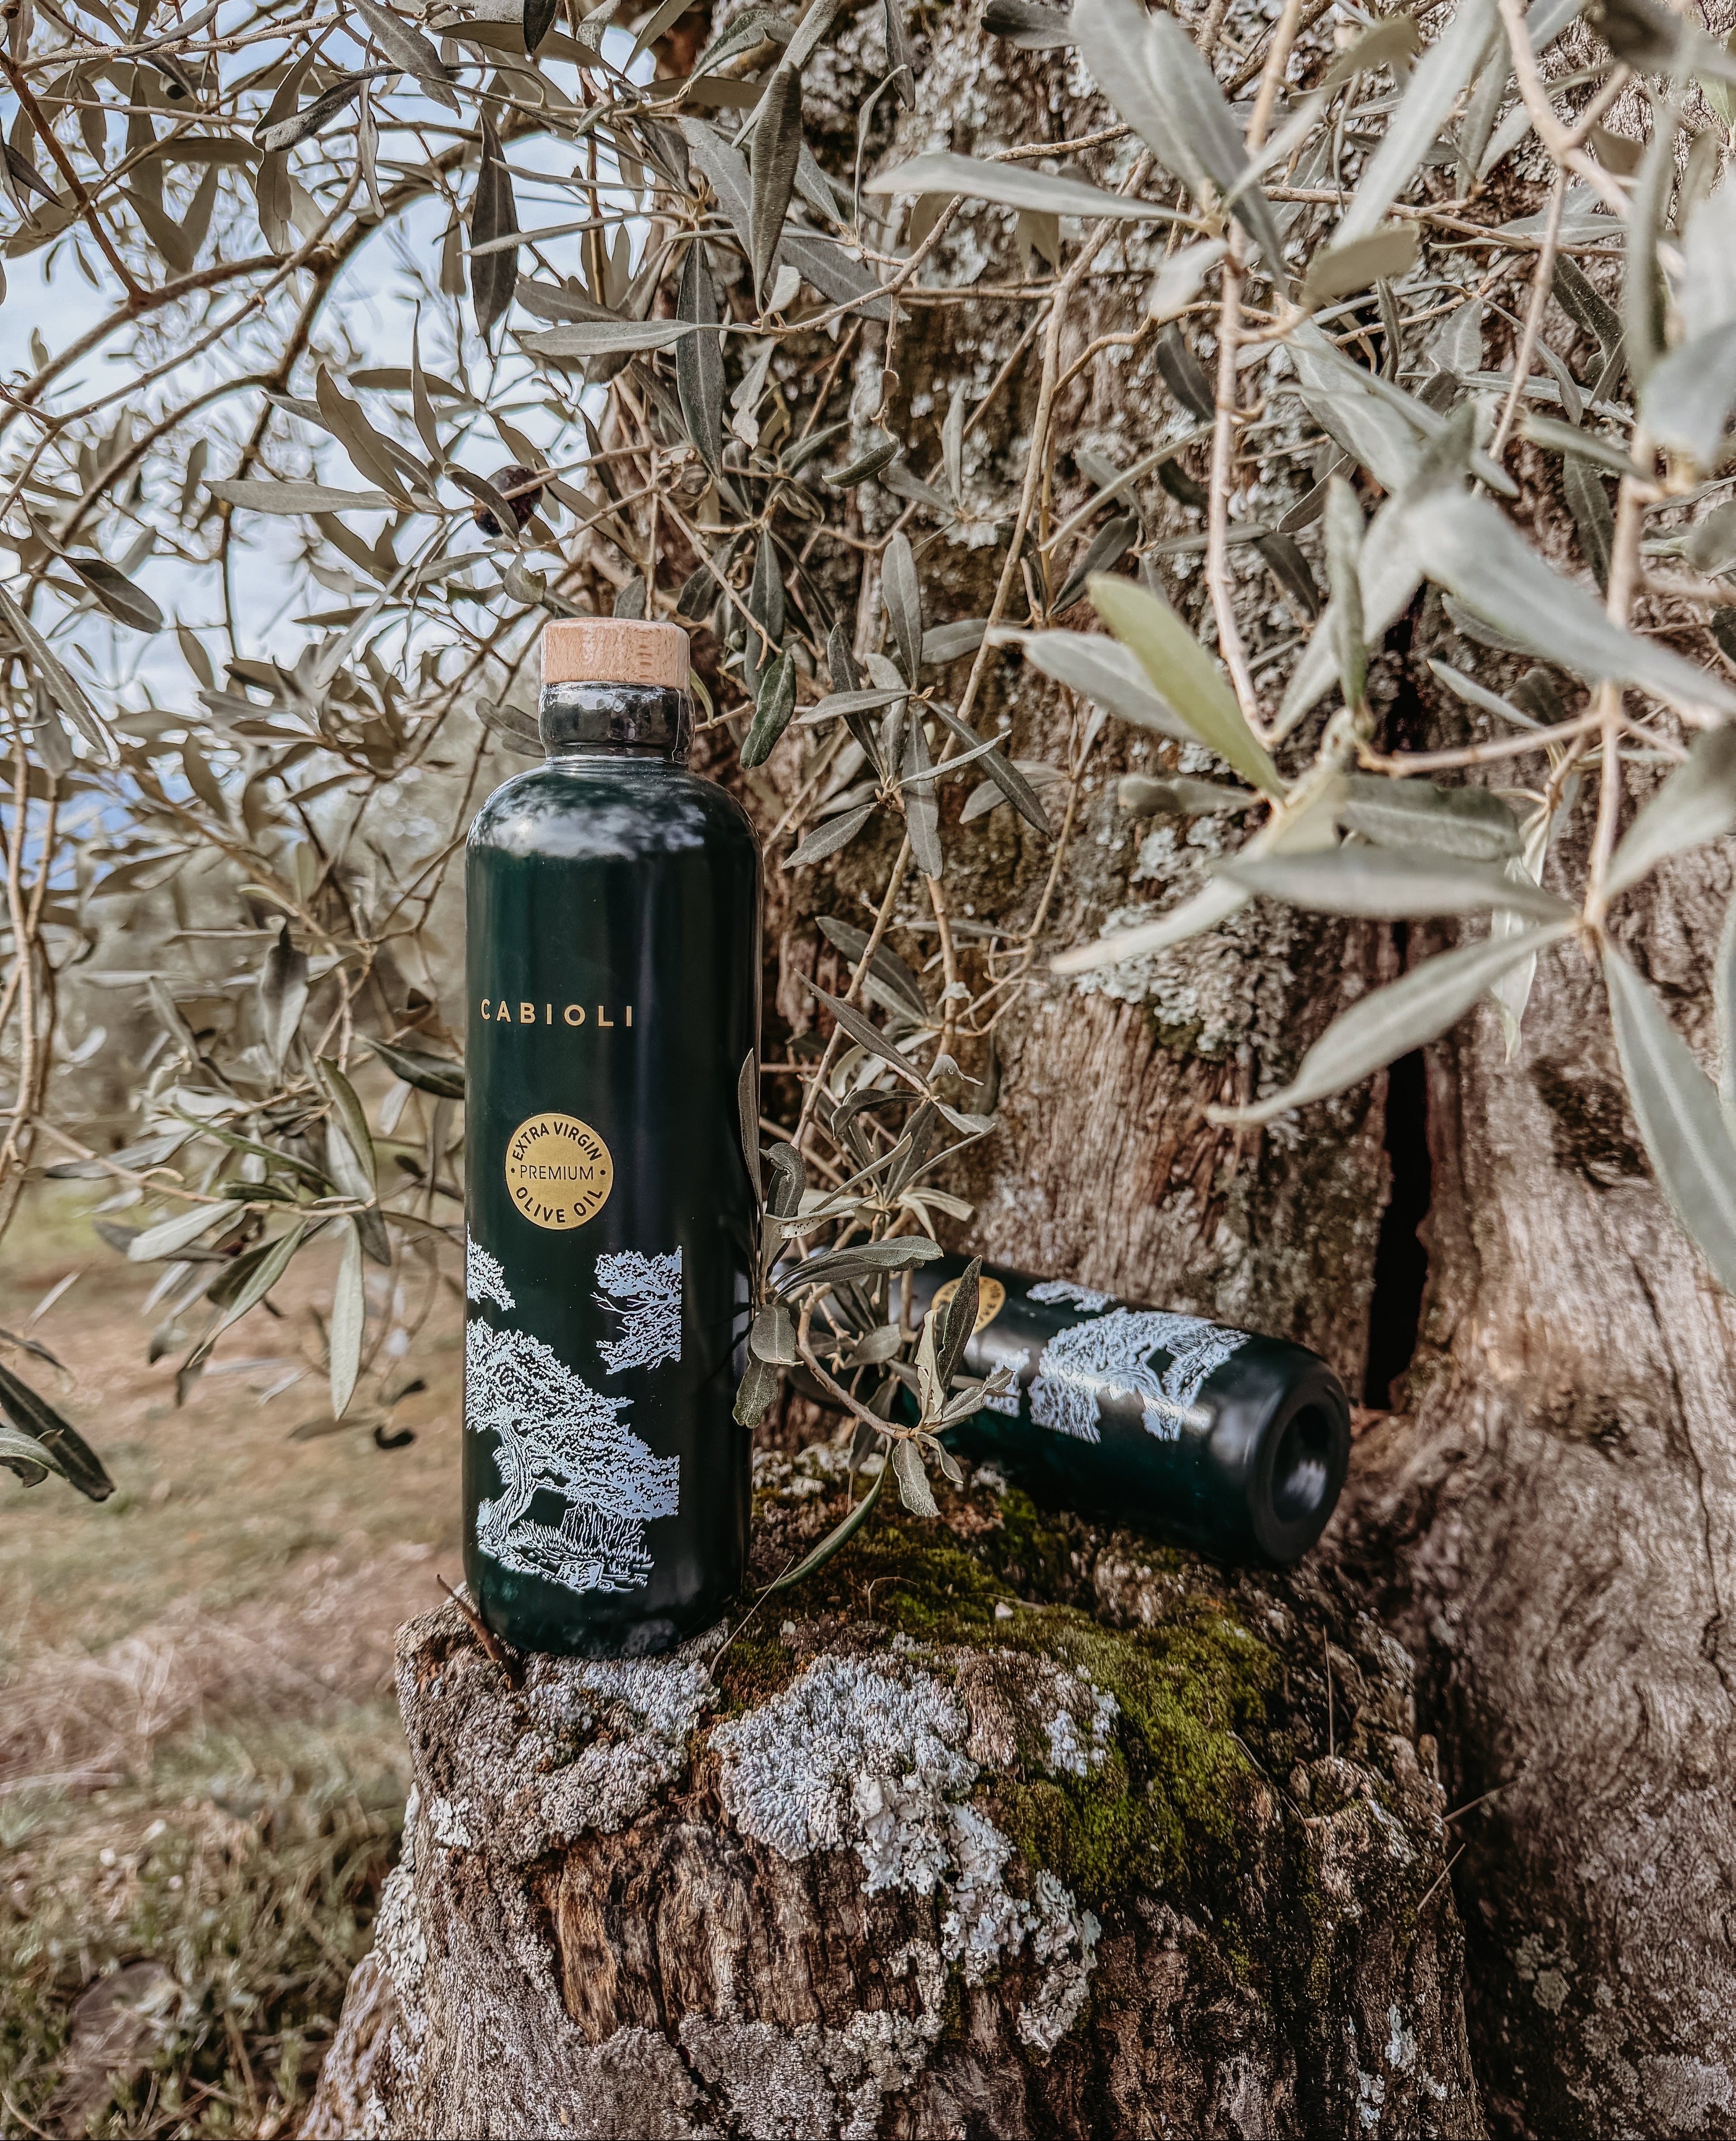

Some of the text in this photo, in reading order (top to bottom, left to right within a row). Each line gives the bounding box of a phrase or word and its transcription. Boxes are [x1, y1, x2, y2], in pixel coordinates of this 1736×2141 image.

[481, 998, 632, 1027] CABIOLI
[512, 1121, 603, 1161] EXTRA VIRGIN
[520, 1164, 594, 1180] PREMIUM
[516, 1186, 603, 1224] OLIVE OIL
